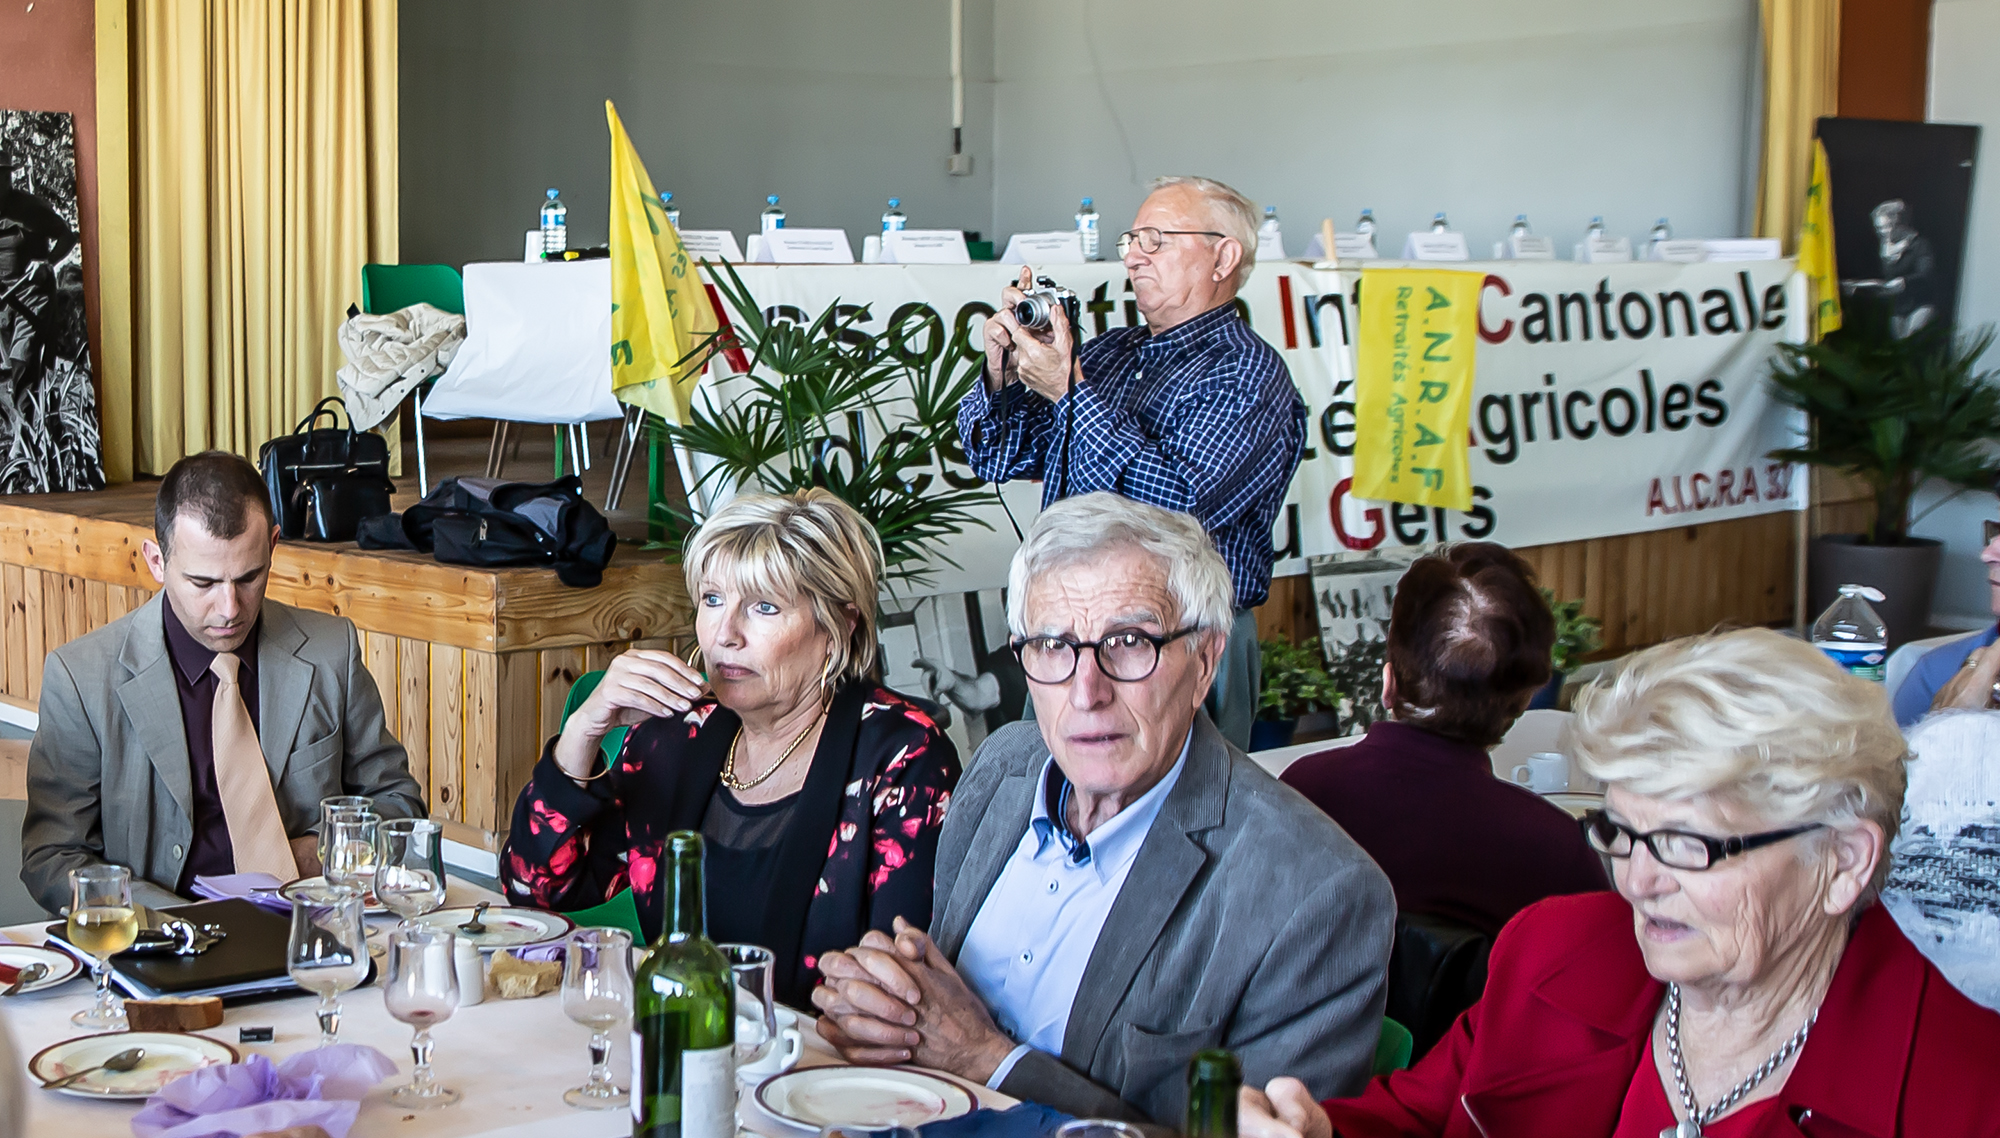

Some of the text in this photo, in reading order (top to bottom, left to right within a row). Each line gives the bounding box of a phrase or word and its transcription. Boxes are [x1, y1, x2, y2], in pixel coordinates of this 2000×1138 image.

[1478, 271, 1787, 344] Cantonale
[1386, 286, 1413, 484] Retraités Agricoles
[1467, 368, 1730, 464] gricoles
